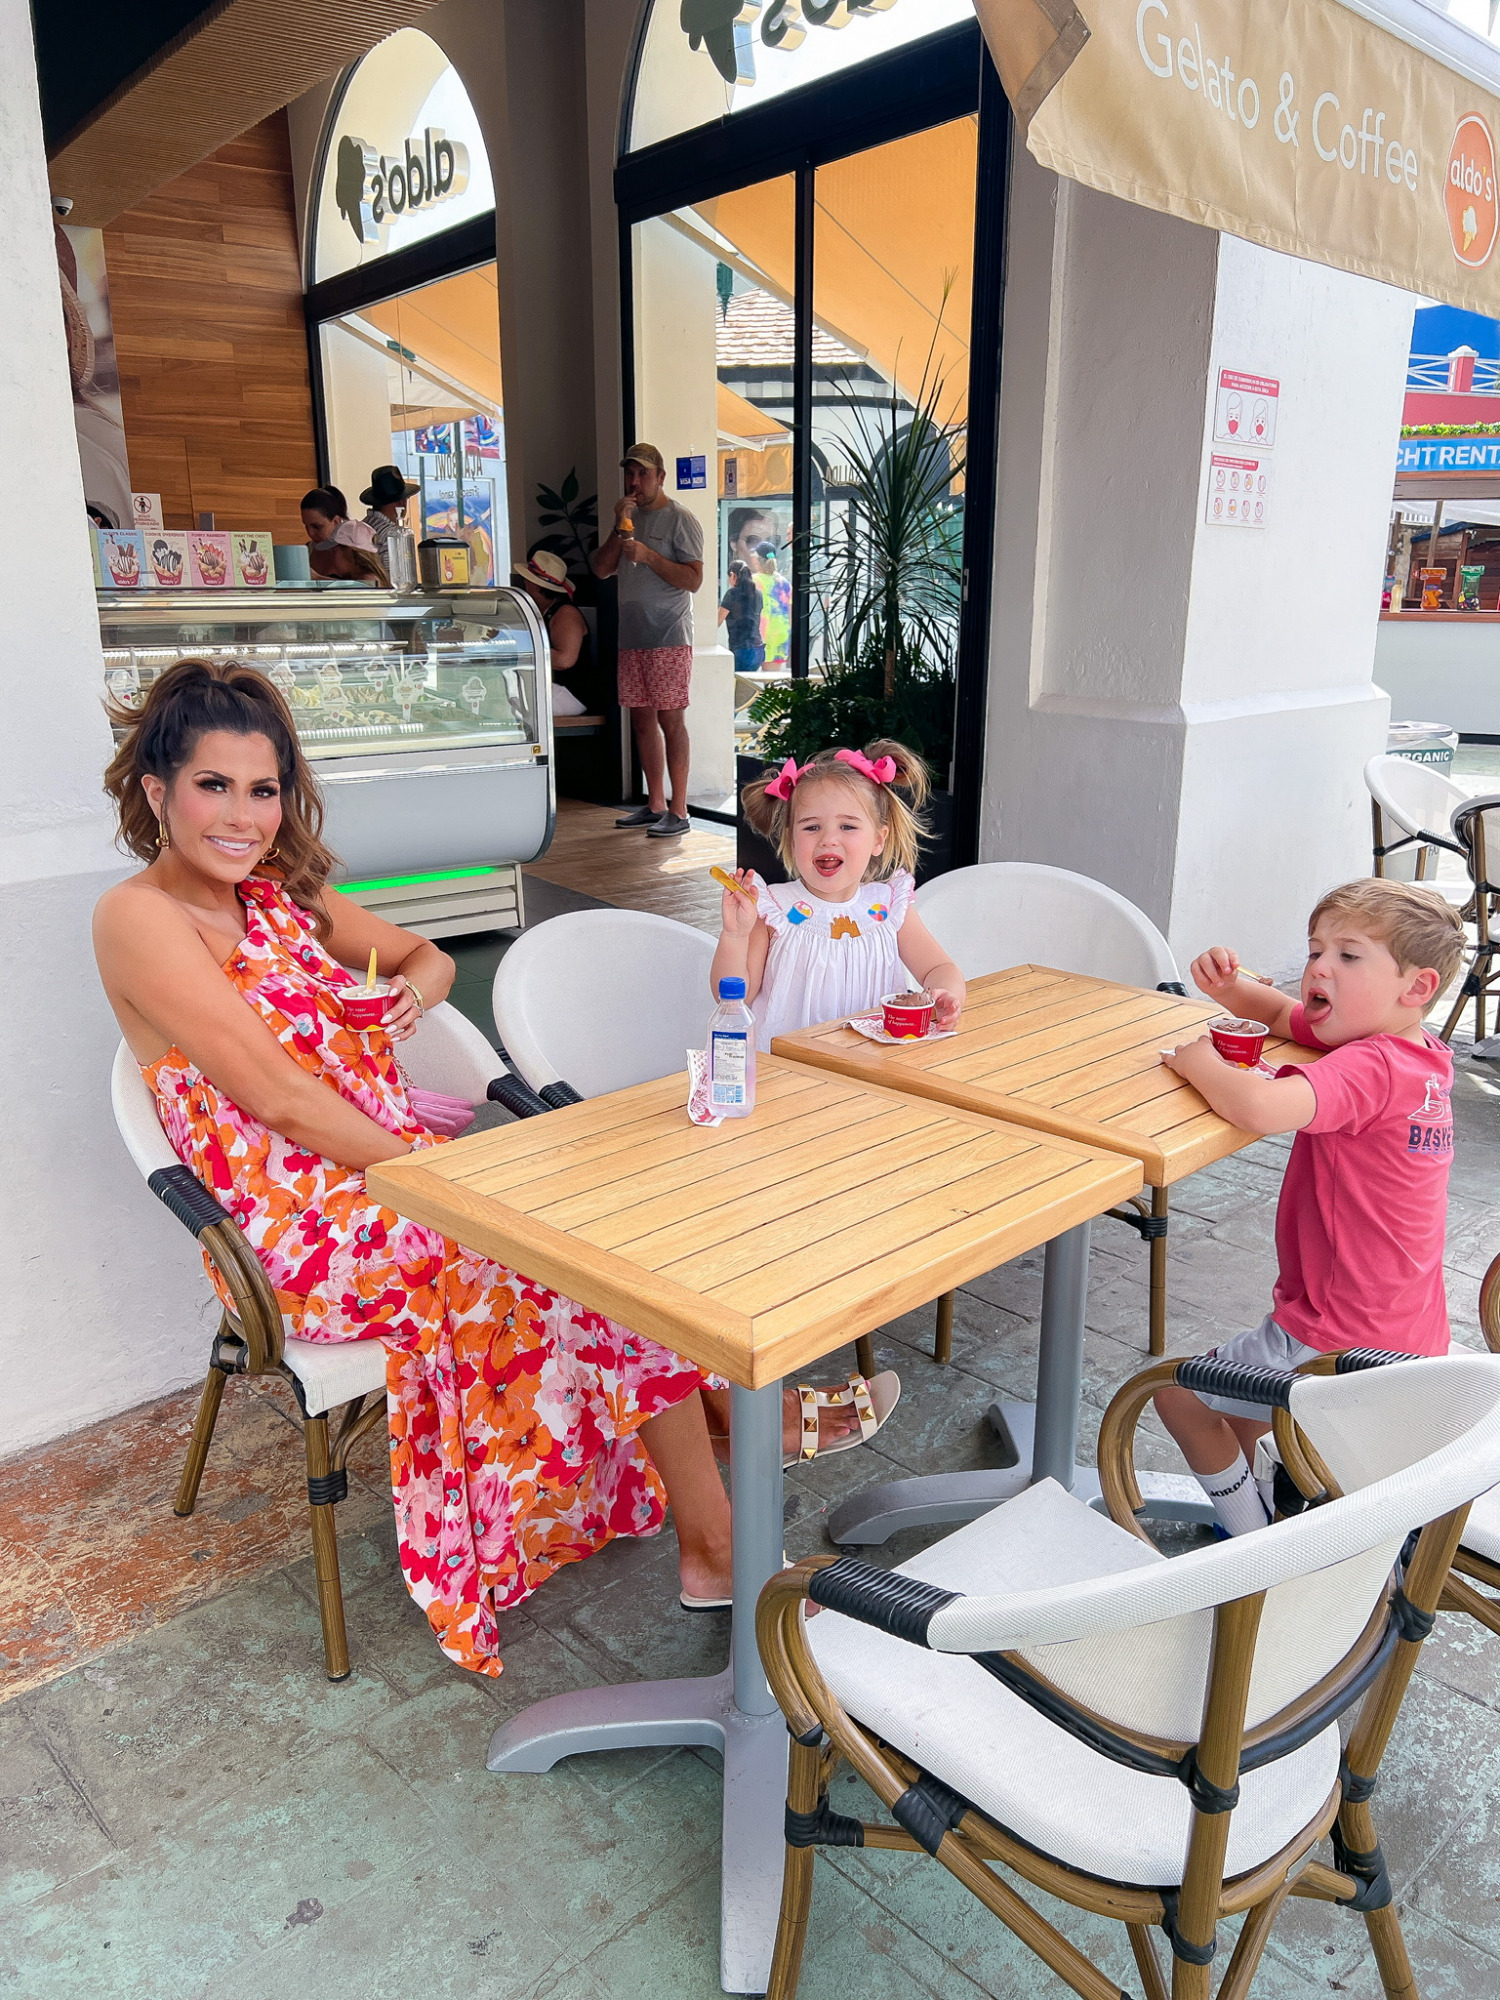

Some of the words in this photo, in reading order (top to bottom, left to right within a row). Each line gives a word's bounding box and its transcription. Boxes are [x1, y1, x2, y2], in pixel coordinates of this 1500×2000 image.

[1136, 0, 1260, 129] Gelato
[1273, 71, 1300, 147] &
[1312, 91, 1418, 191] Coffee
[1450, 152, 1492, 202] aldo's
[1439, 445, 1500, 465] RENT
[1407, 1124, 1453, 1152] BASKE
